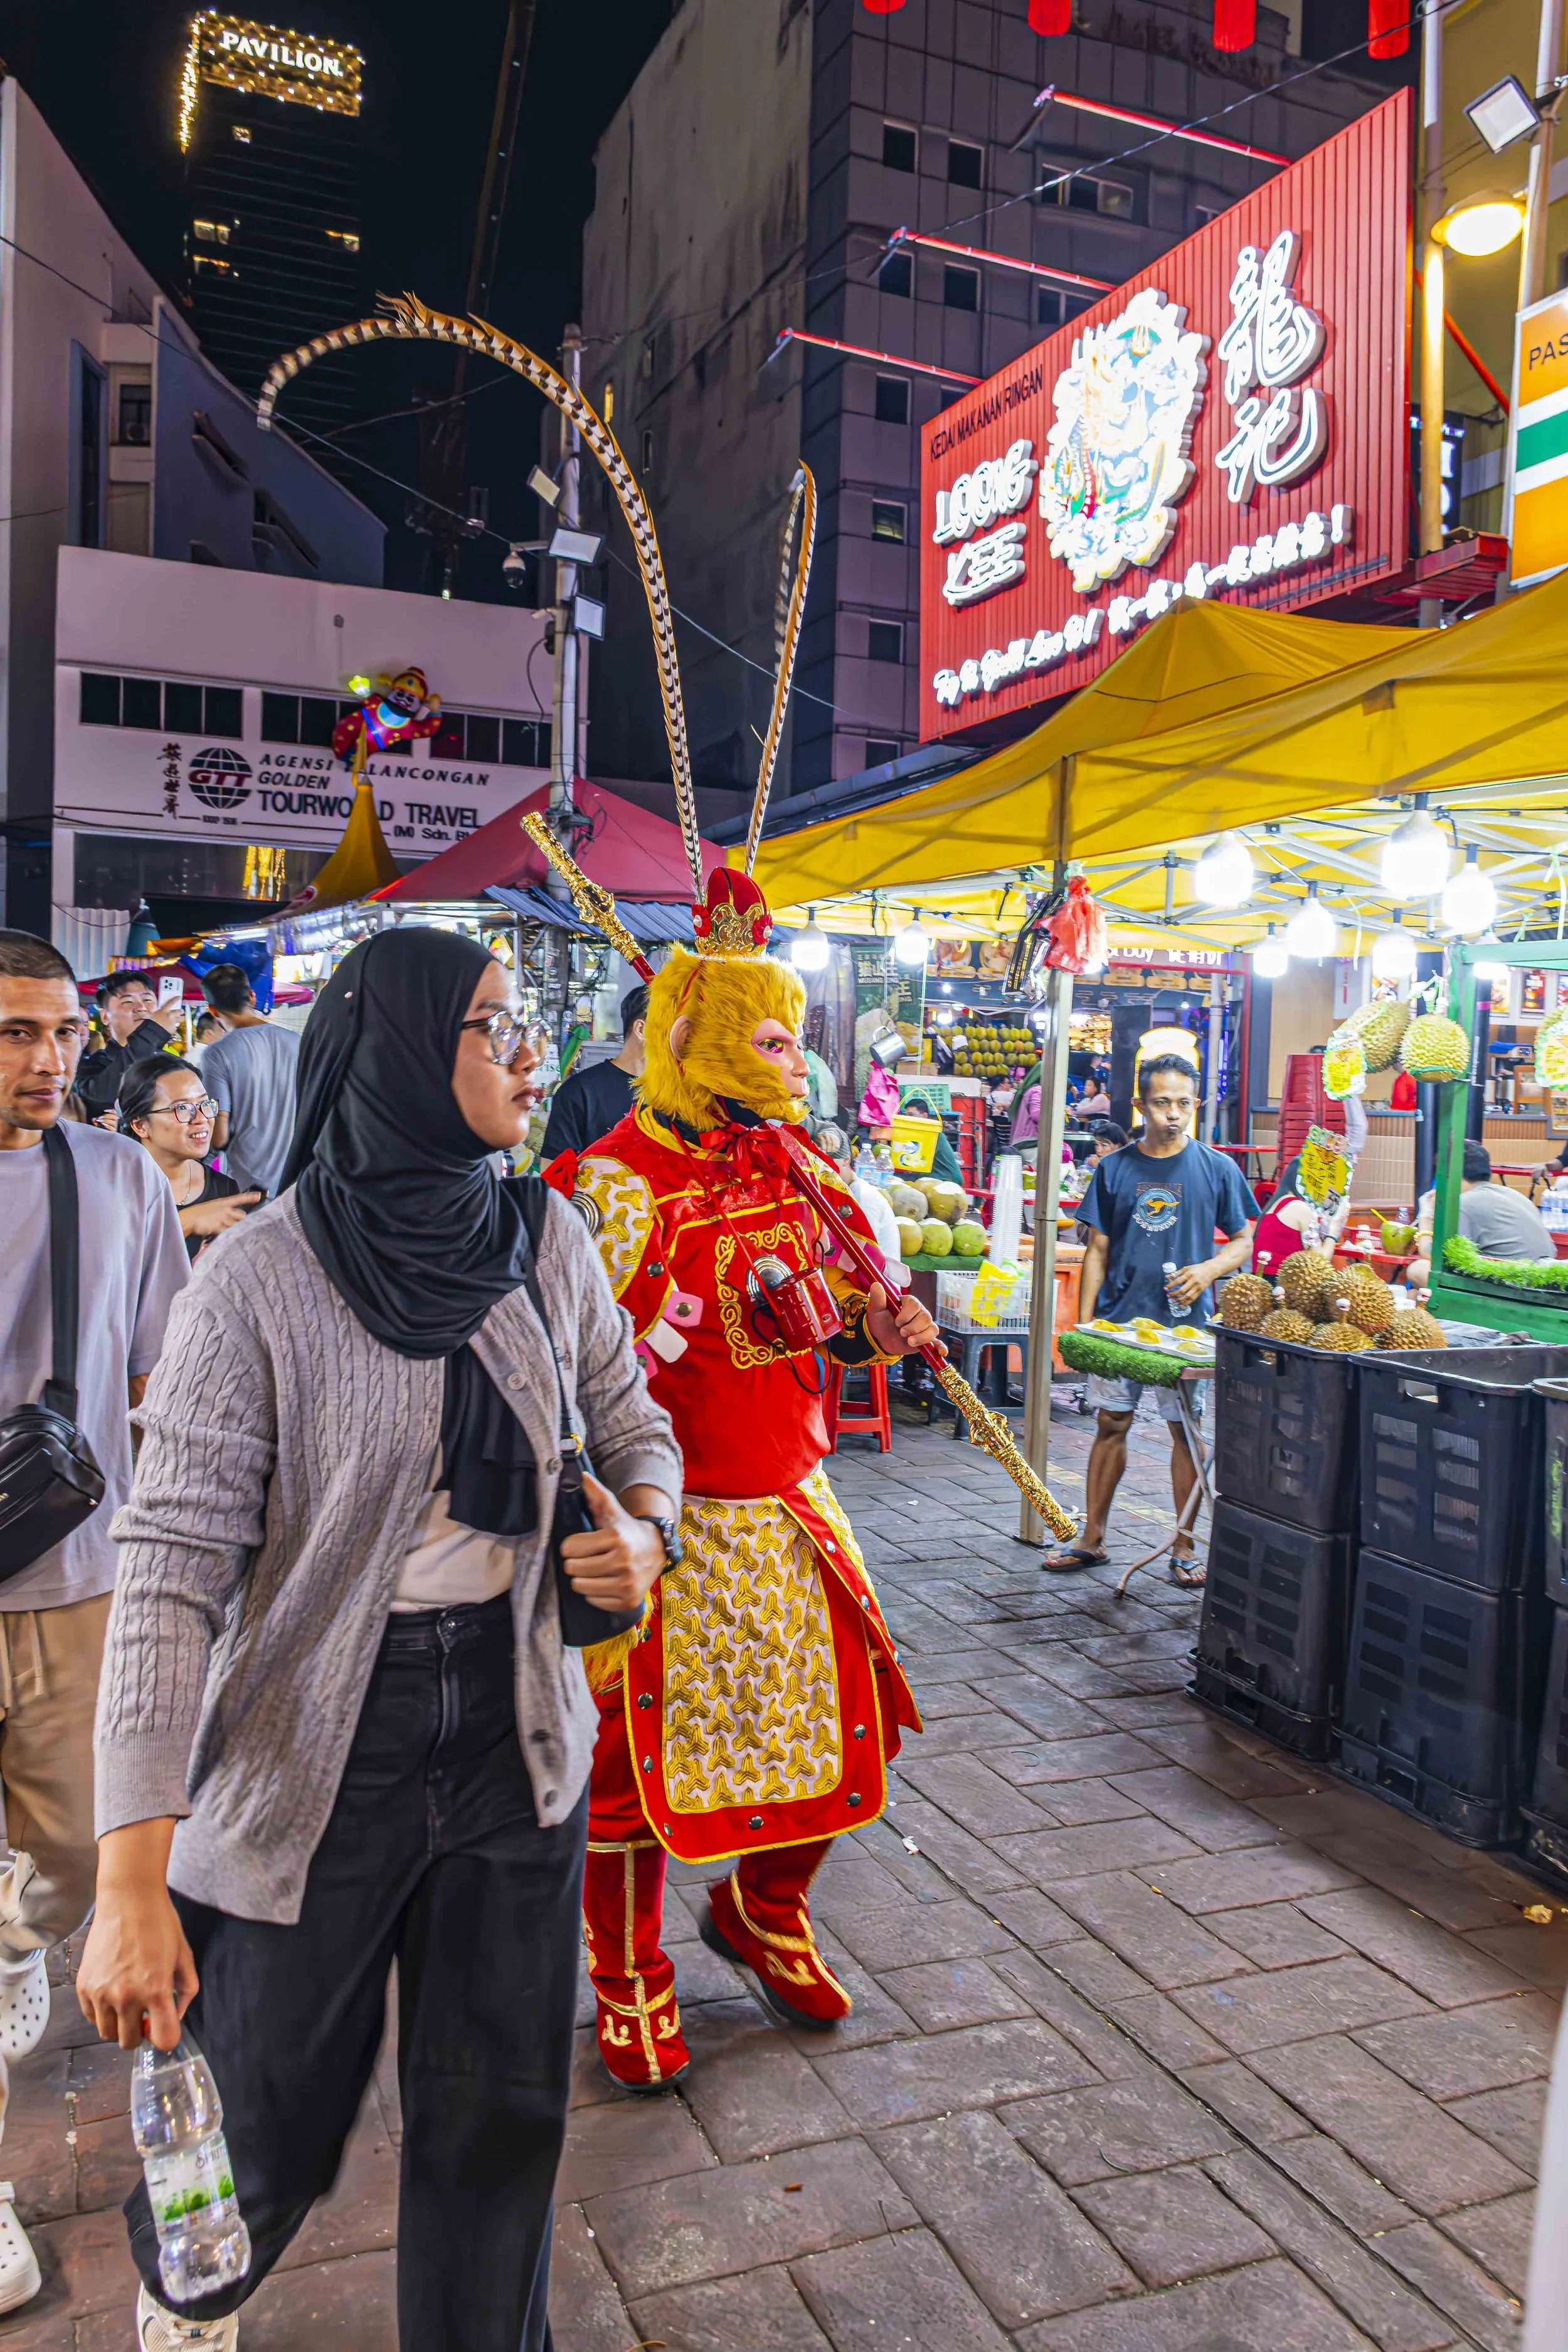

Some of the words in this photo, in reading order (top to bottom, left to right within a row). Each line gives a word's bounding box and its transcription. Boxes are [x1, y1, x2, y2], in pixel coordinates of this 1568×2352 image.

[221, 30, 341, 77] PAVILION
[931, 423, 955, 463] KEDAI
[957, 391, 1002, 444] MAKANAN
[1004, 364, 1043, 415] RINGAN
[933, 438, 1037, 544] LOONG
[942, 522, 1026, 606] KEE
[189, 769, 252, 787] GTT
[258, 771, 331, 790] GOLDEN
[259, 753, 334, 771] AGENSI
[257, 789, 395, 822] TOURWOD
[403, 802, 484, 830] TRAVEL
[421, 827, 452, 840] Sdn.
